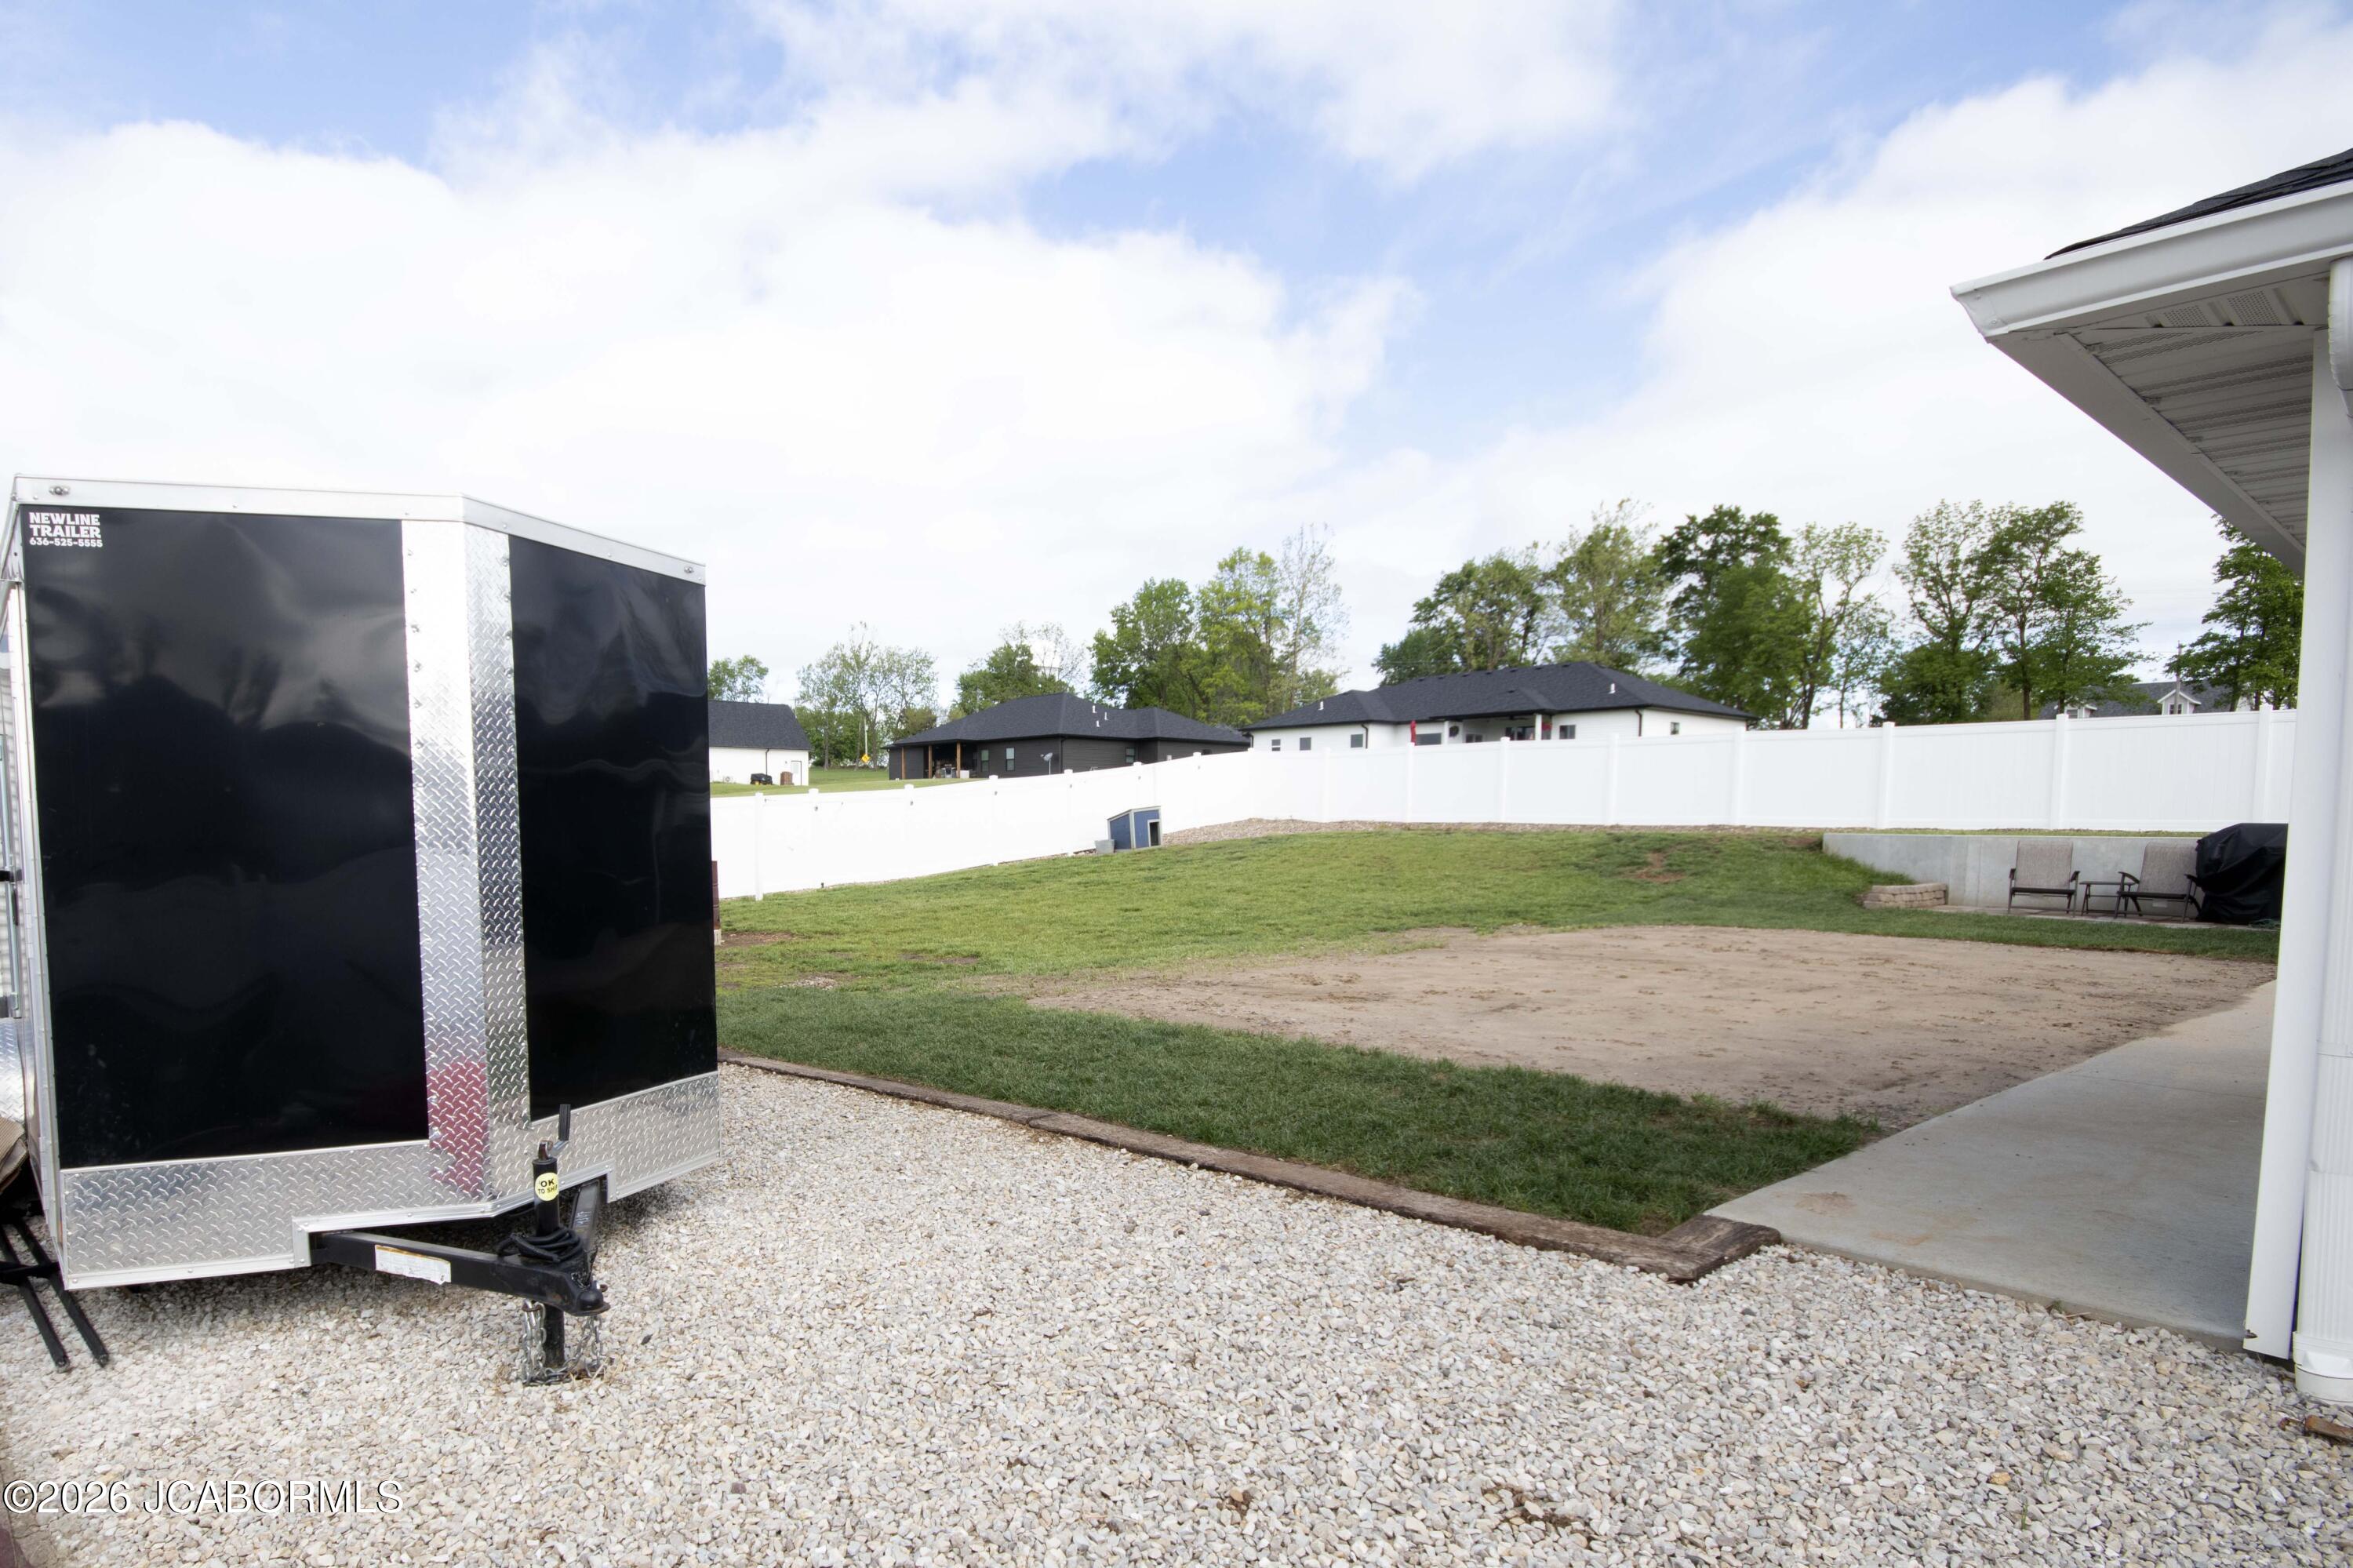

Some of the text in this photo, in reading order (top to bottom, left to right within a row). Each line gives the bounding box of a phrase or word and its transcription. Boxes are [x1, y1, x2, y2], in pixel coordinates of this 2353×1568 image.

[28, 511, 100, 526] NEWLINE
[28, 525, 101, 539] TRAILER
[29, 538, 103, 548] 636-525-5555
[540, 1178, 555, 1187] OK
